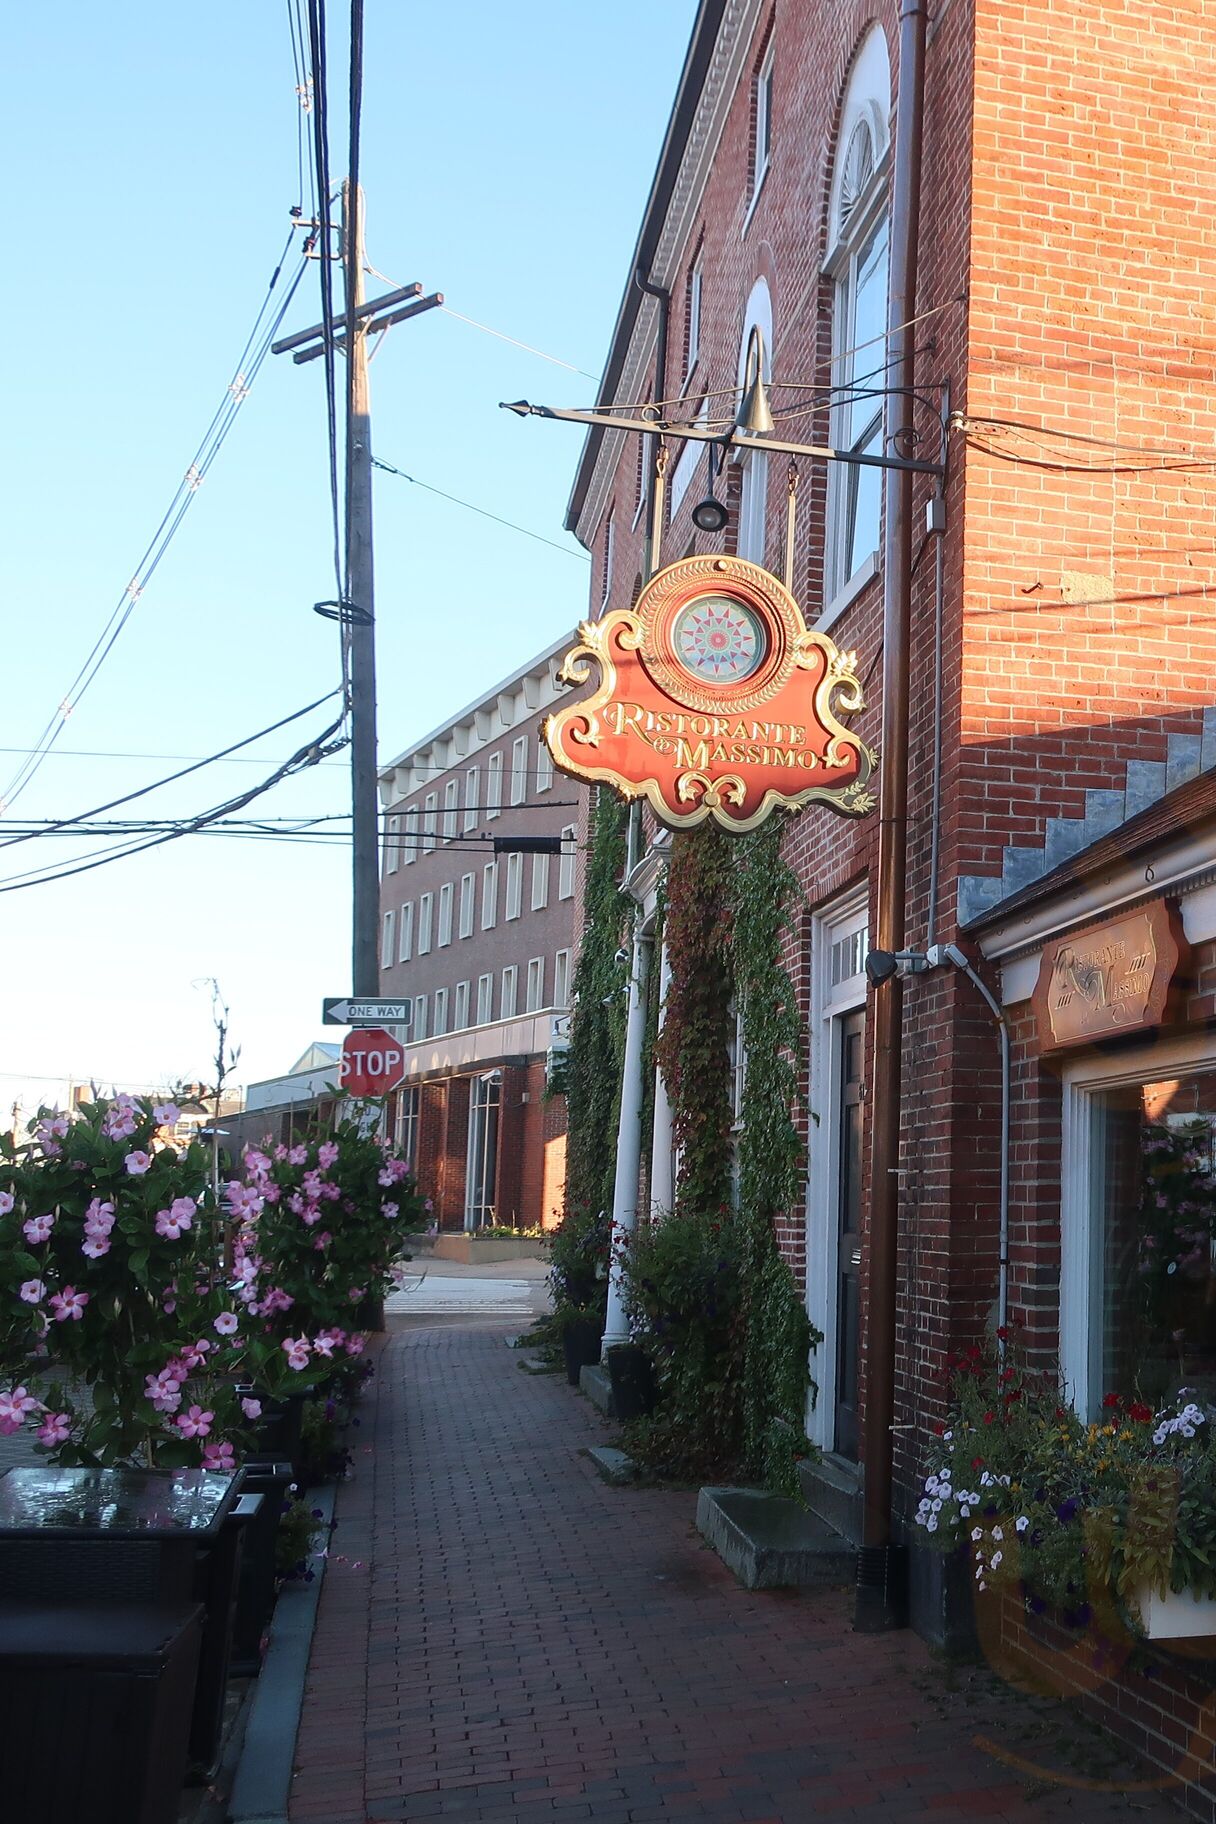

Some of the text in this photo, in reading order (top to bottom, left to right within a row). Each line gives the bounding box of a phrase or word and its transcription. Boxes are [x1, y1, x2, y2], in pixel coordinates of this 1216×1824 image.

[602, 702, 806, 744] RISTORANTE
[672, 736, 819, 771] MASSIMO
[348, 1006, 401, 1016] ONE WAY
[341, 1050, 400, 1077] STOP
